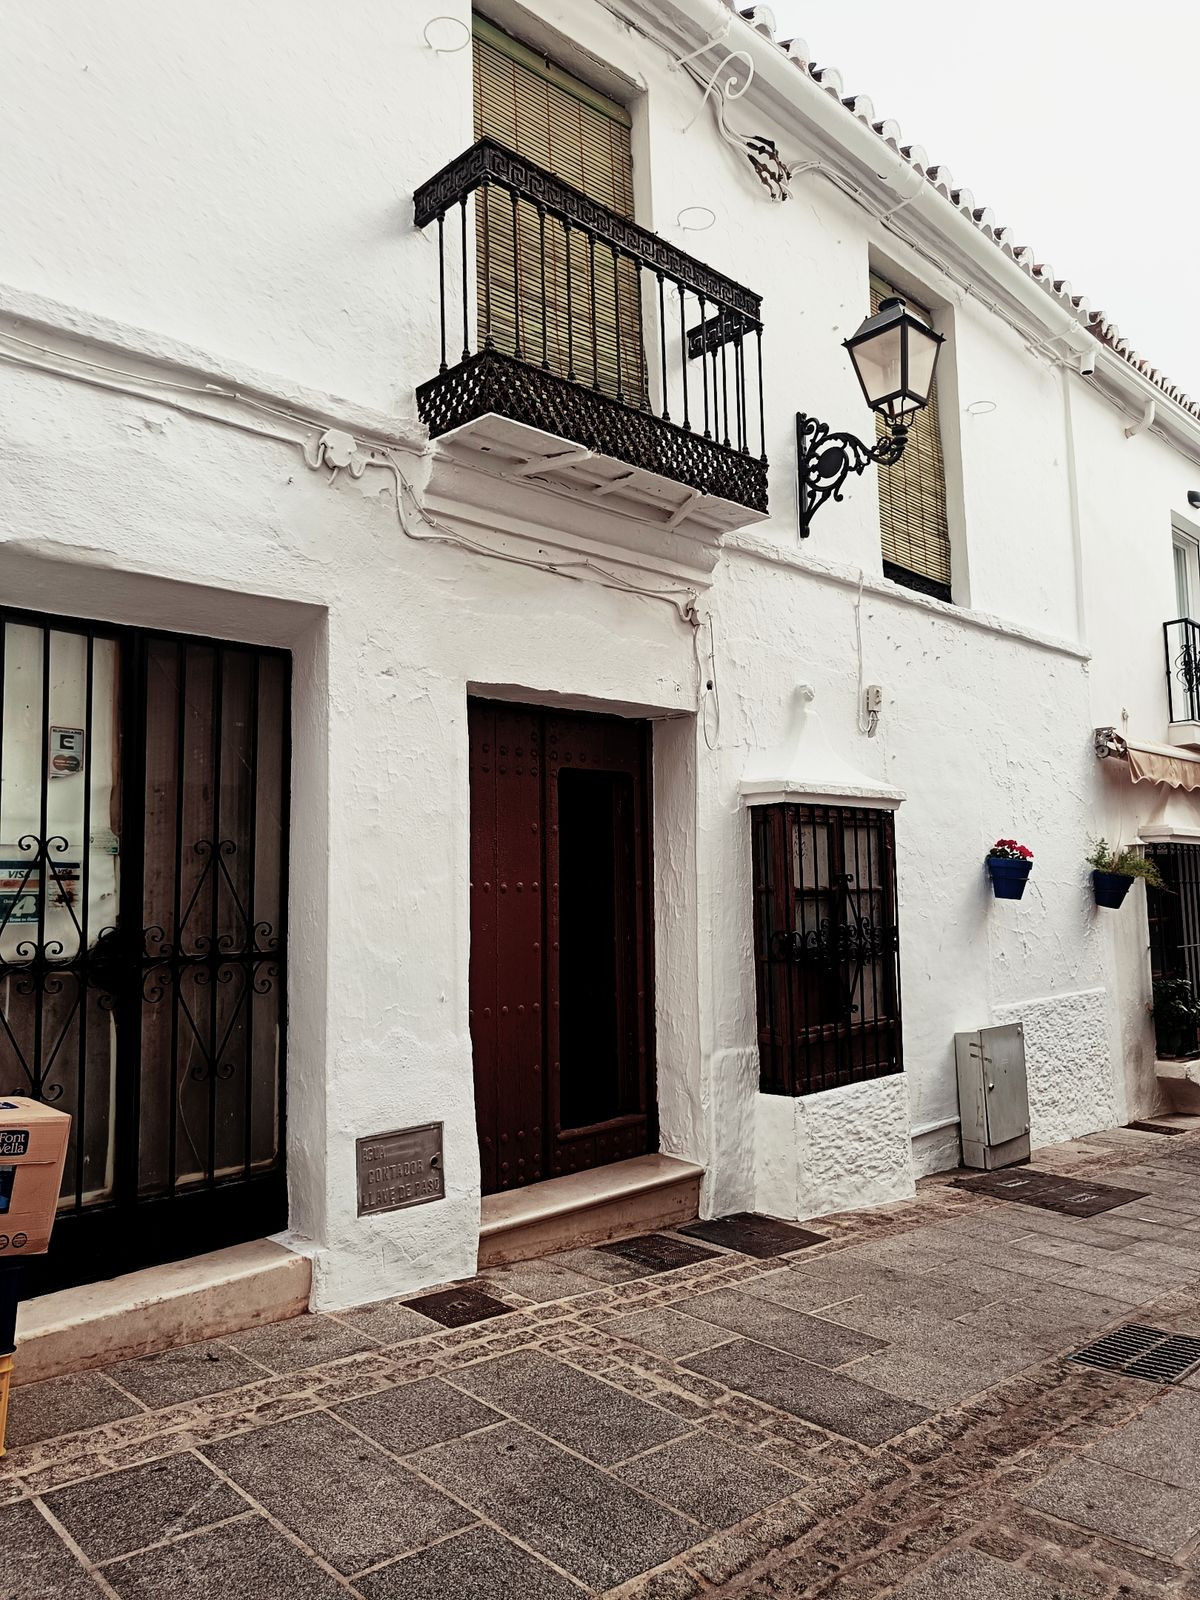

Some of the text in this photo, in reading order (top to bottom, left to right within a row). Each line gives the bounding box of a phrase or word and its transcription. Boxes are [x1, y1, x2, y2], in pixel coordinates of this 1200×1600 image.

[0, 1132, 26, 1143] Font
[368, 1159, 424, 1185] CONTADOR
[362, 1177, 440, 1208] LLAVE DE PASO
